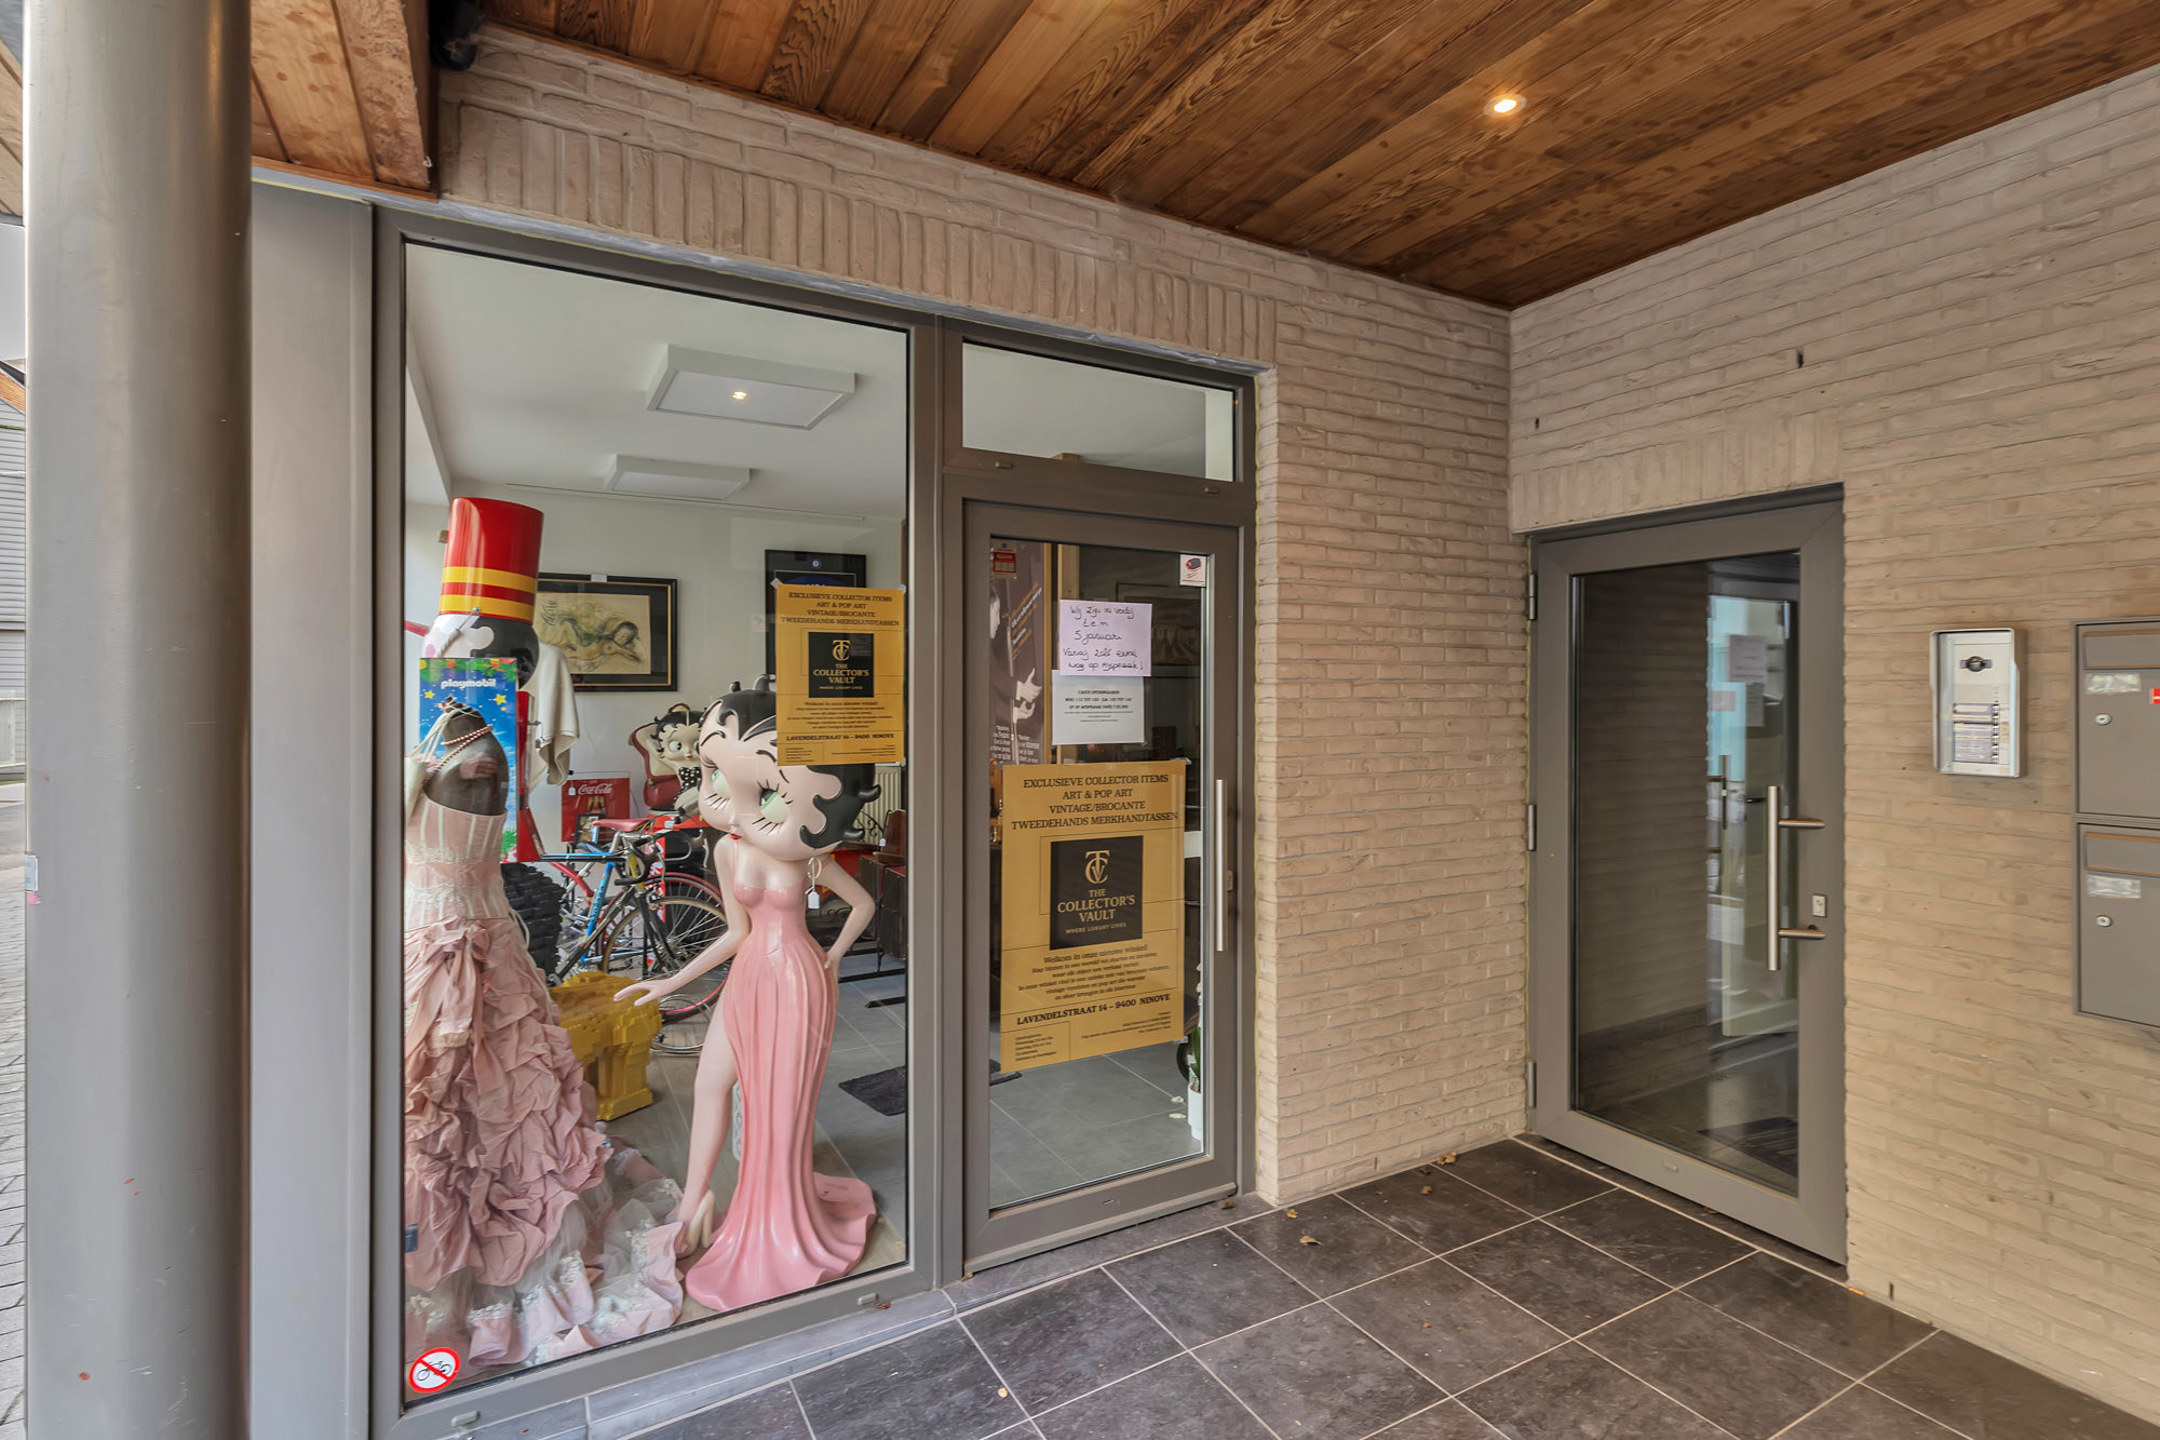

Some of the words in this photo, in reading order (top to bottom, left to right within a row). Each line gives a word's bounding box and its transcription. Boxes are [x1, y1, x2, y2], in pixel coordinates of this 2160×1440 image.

[788, 592, 831, 600] EXCLUSIEVE
[832, 593, 871, 602] COLLECTOR
[807, 609, 876, 618] VINTAGE/BROCANTE
[782, 616, 836, 625] TWEEDEHANDS
[836, 618, 900, 626] MERKHANDTASSEN
[1075, 630, 1081, 640] 5
[440, 678, 496, 690] playmobil
[1024, 778, 1083, 788] EXCLUSIEVE
[1085, 775, 1138, 785] COLLECTOR
[1141, 774, 1168, 783] ITEMS
[1063, 790, 1082, 799] ART
[1084, 790, 1092, 799] &
[1094, 790, 1112, 798] POP
[1114, 788, 1133, 797] ART
[1049, 801, 1146, 813] VINTAGE/BROCANTE
[1011, 817, 1088, 830] TWEEDEHANDS
[1091, 812, 1178, 824] MERKHANDTASSEN
[1089, 889, 1106, 898] THE
[1057, 895, 1136, 913] COLLECTOR'S
[1079, 909, 1116, 922] VAULT
[1016, 1005, 1097, 1025] LAVENDELSTRAAT
[1115, 998, 1136, 1009] 9400
[1139, 994, 1171, 1005] NINOVE
